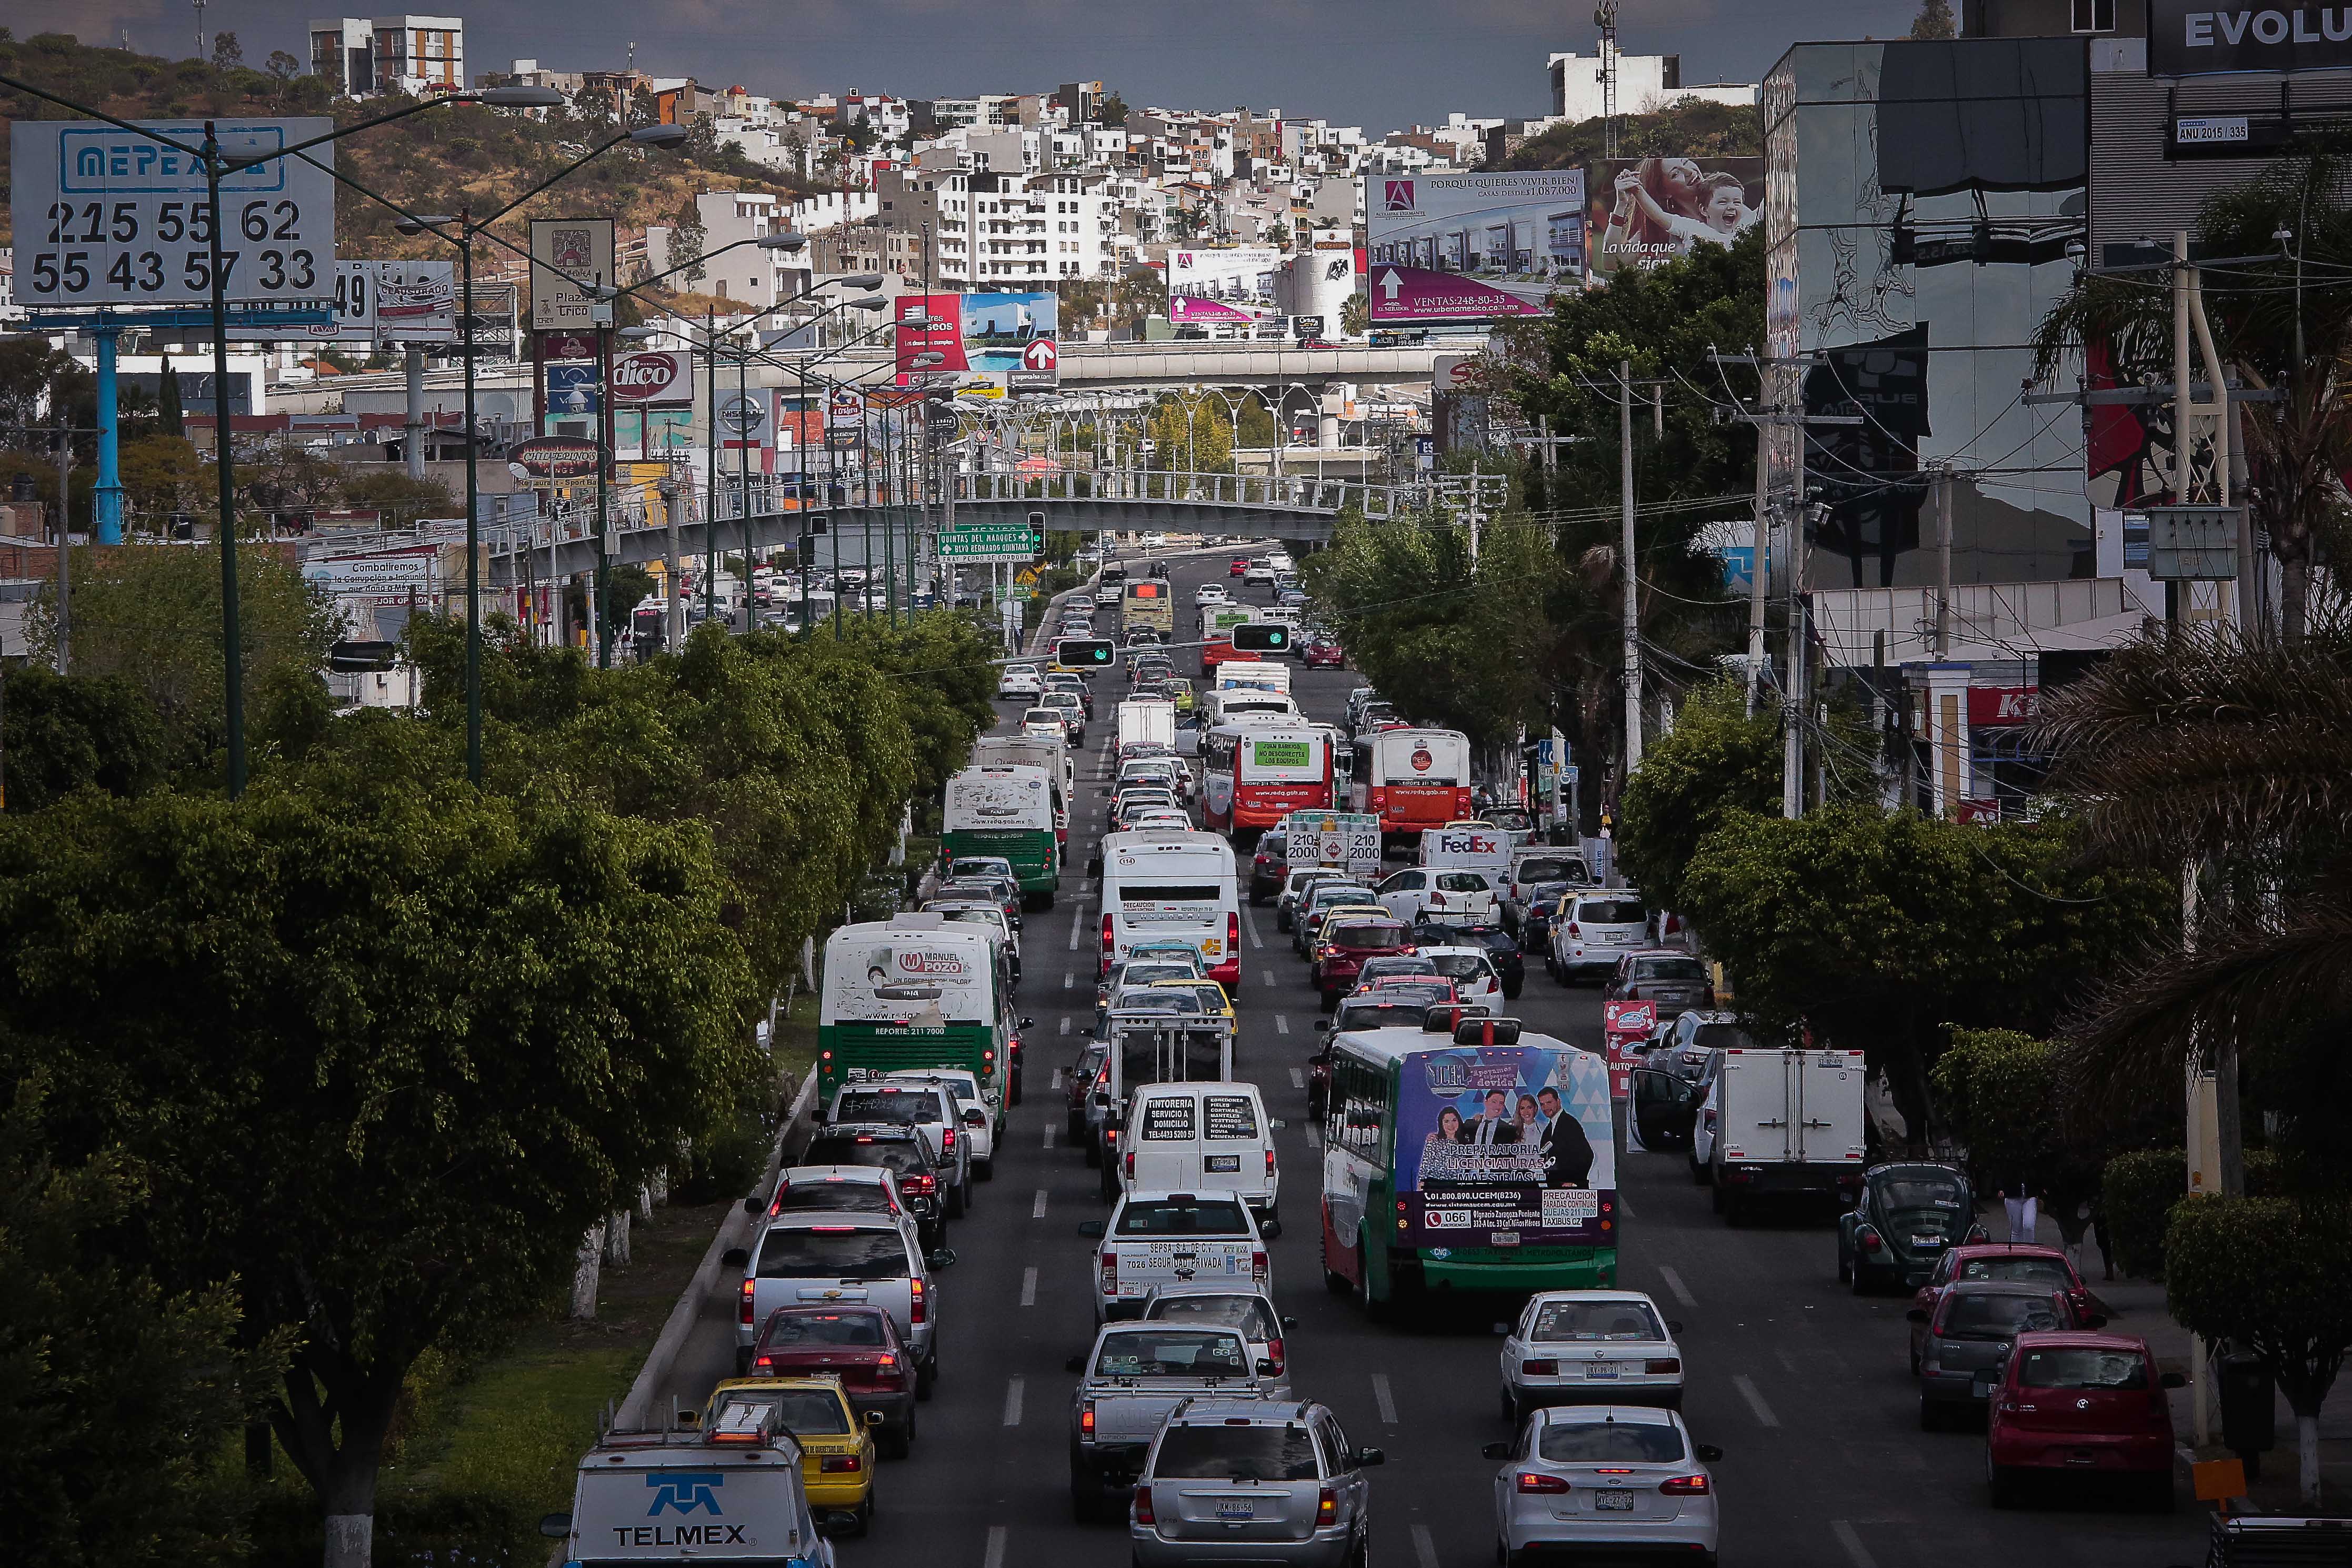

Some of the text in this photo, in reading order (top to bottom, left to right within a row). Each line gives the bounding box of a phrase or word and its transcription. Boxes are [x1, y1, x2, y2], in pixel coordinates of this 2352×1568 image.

[2186, 7, 2352, 47] EVOLU
[2179, 128, 2199, 139] ANU
[2201, 127, 2223, 138] 2015
[2229, 126, 2246, 137] 335
[1430, 176, 1578, 189] PORQUE QUIERES VIVIR BIEN!
[47, 200, 301, 243] 215 55 62
[1603, 240, 1676, 256] La vida que
[32, 249, 316, 293] 55 43 57 33
[381, 285, 449, 295] CLAUSURADO
[556, 293, 589, 303] Plaza
[613, 360, 671, 385] dico
[941, 535, 969, 543] QUINTAS
[986, 534, 1016, 542] MARQUES
[970, 544, 1000, 552] BERNARDO
[1002, 543, 1029, 551] QUINTANA
[352, 563, 418, 572] Combatiremos
[344, 574, 386, 584] Corrupción
[1293, 835, 1314, 846] 210
[1354, 835, 1375, 846] 210
[1440, 836, 1497, 853] FedEx
[1288, 847, 1319, 858] 2000
[1349, 847, 1380, 859] 2000
[924, 953, 959, 961] MANUEL
[924, 962, 959, 972] POZO
[1434, 1064, 1468, 1086] UCEM
[1449, 1144, 1541, 1155] PREPARATORIA
[1447, 1158, 1545, 1170] LICENCIATURAS
[1445, 1212, 1466, 1222] 066
[1495, 1211, 1518, 1219] Zaragoza
[1176, 1243, 1189, 1253] S.A.
[1191, 1243, 1199, 1252] DE
[1149, 1258, 1188, 1268] SEGURIDAD
[1192, 1257, 1222, 1268] PRIVADA
[612, 1524, 746, 1547] TELMEX
